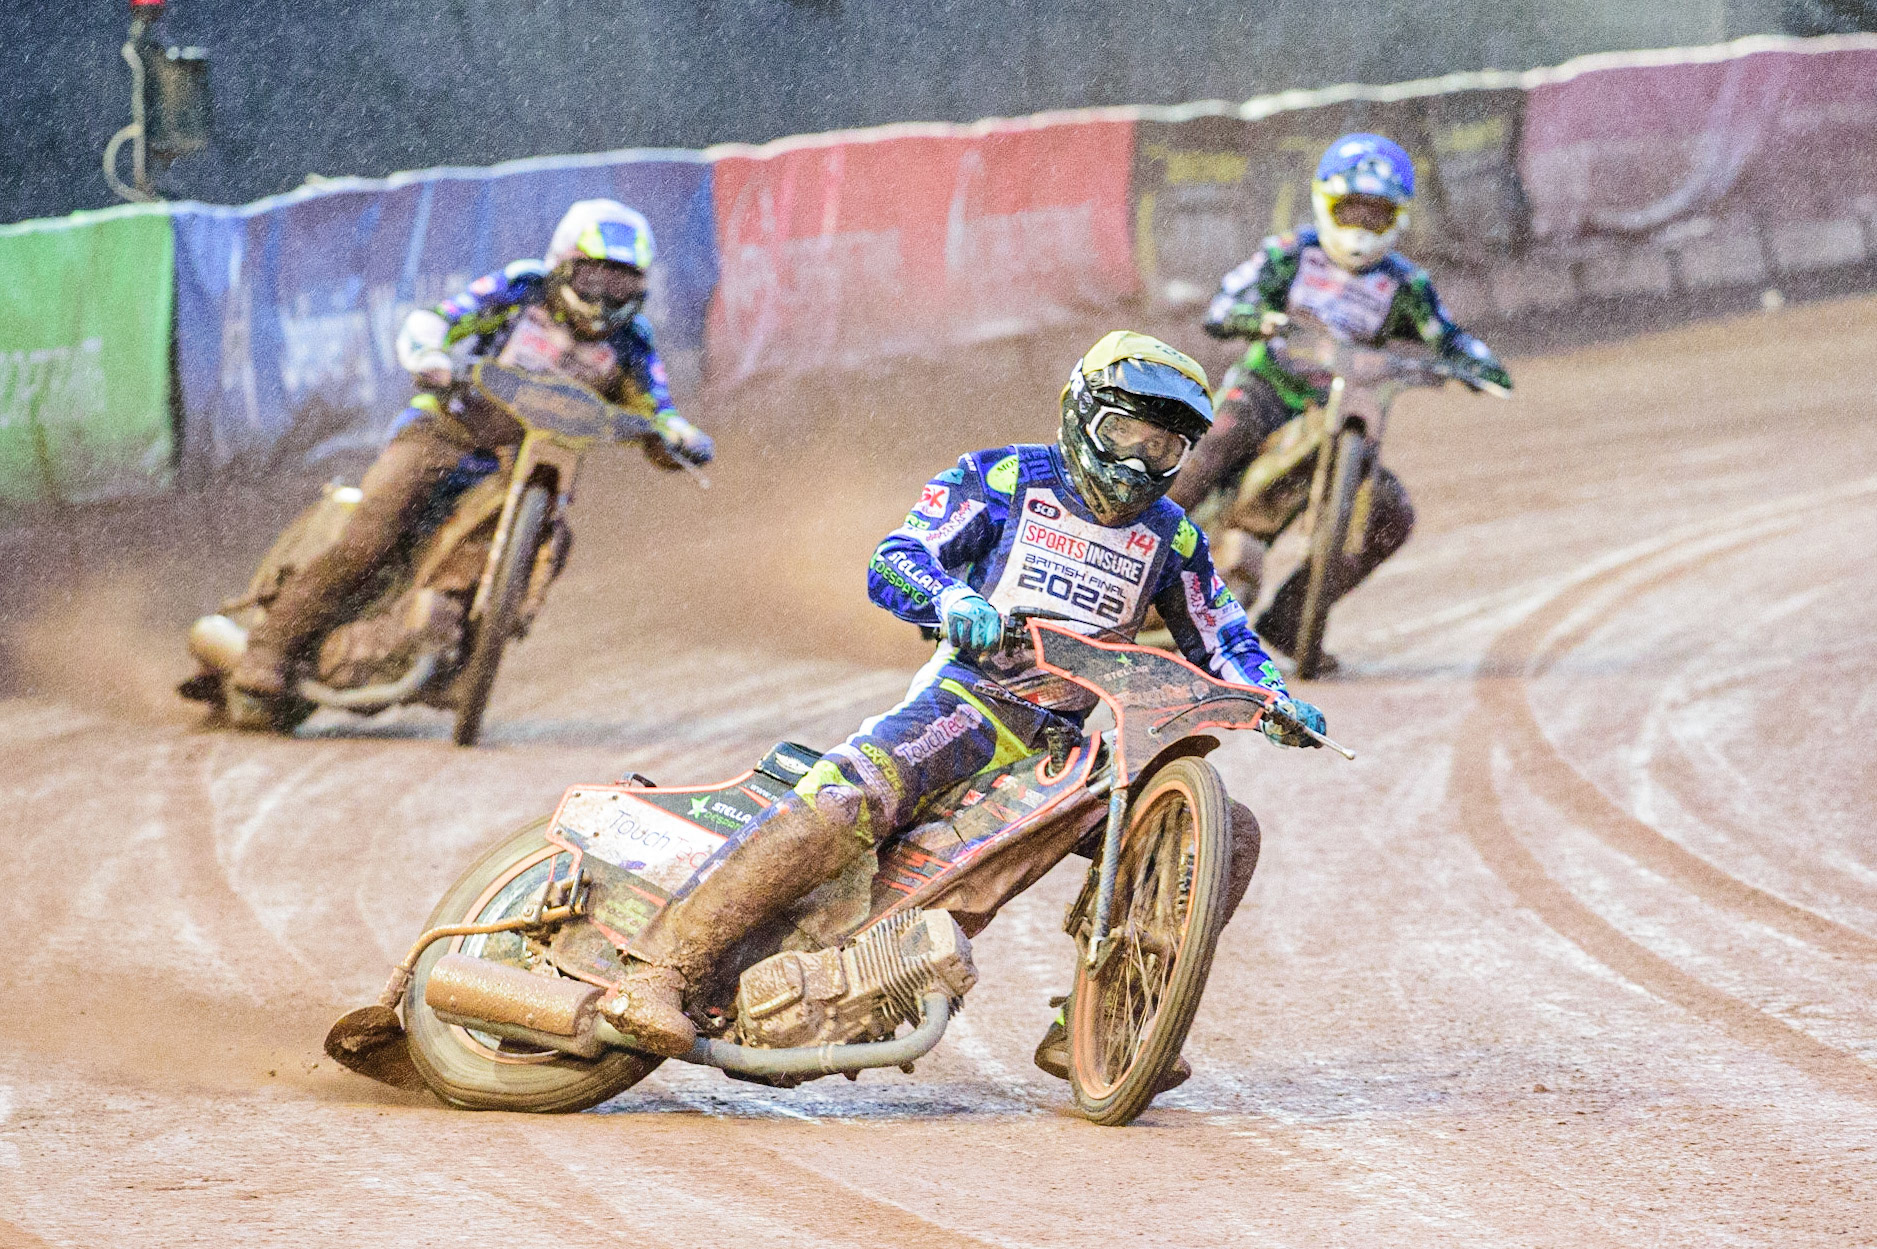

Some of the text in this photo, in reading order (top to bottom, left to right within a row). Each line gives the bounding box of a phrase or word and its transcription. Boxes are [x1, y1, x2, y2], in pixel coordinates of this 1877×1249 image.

[1034, 501, 1056, 518] SCB
[1026, 525, 1143, 582] SPORTS INSURE
[1125, 531, 1156, 556] 14
[888, 551, 944, 595] STELLAR
[1017, 563, 1125, 623] 2022
[1024, 553, 1127, 599] BRITISH FINAL
